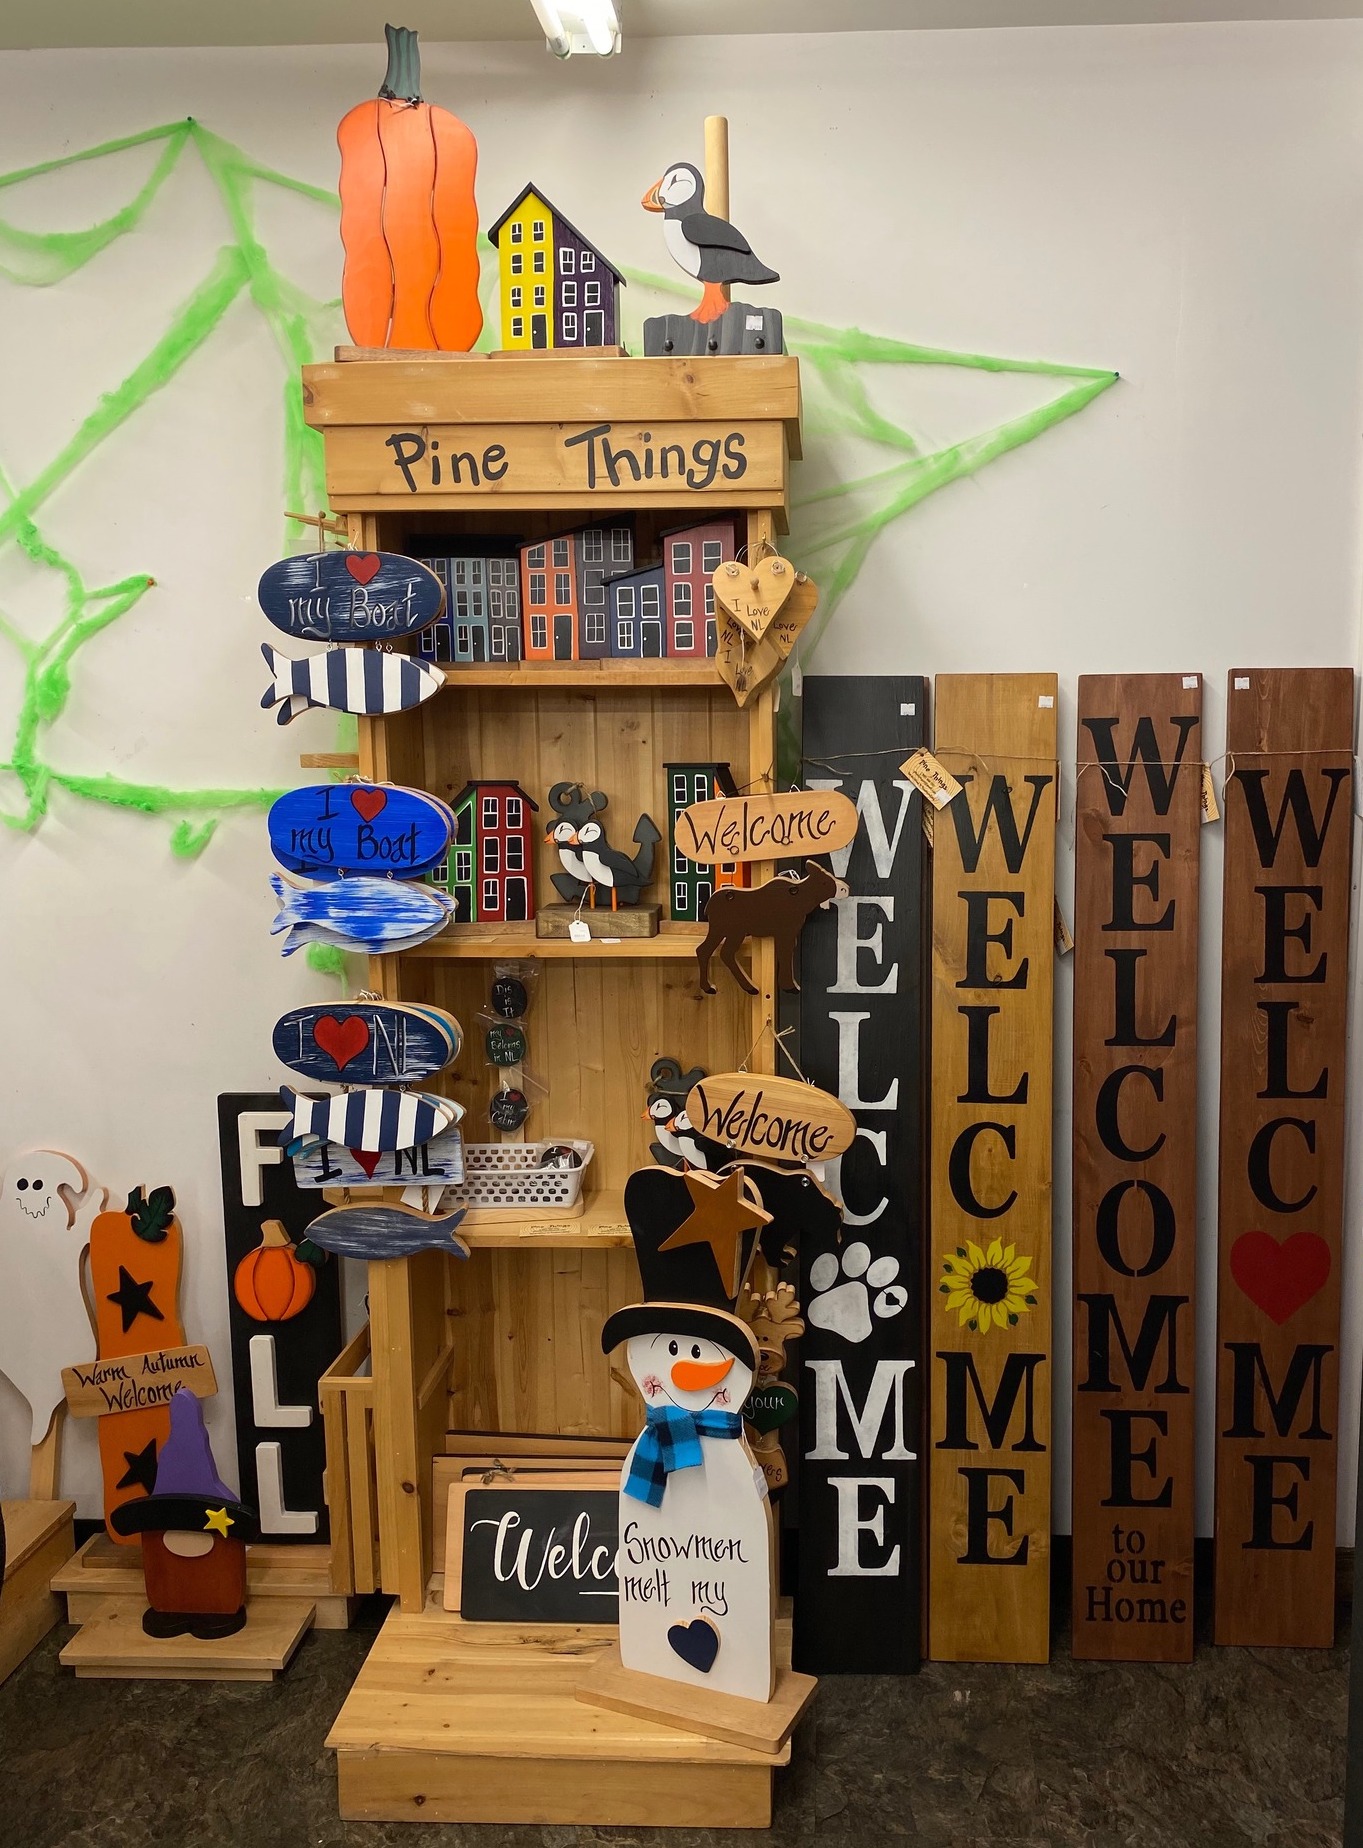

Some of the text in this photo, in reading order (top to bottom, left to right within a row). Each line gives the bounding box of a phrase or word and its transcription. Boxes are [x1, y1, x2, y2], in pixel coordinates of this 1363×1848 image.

[385, 424, 748, 493] Pine Things
[306, 553, 329, 593] I
[288, 582, 420, 638] my Boat
[731, 598, 771, 617] I Love
[750, 618, 766, 631] NL
[773, 621, 799, 632] Love
[779, 633, 794, 644] NL
[315, 786, 341, 821] I
[291, 822, 423, 865] my Boat
[684, 801, 837, 855] Welcome
[282, 1014, 428, 1077] I NL
[504, 1050, 520, 1063] NL
[696, 1084, 835, 1160] Welcome
[1076, 716, 1199, 1507] WELCOME
[72, 1351, 206, 1388] Warm Autumn
[99, 1378, 187, 1412] Welcome
[470, 1511, 619, 1590] Welc
[624, 1521, 750, 1564] Snowmen
[1113, 1524, 1146, 1554] to
[1106, 1555, 1164, 1584] our
[624, 1568, 729, 1616] melt my
[1085, 1587, 1187, 1624] Home
